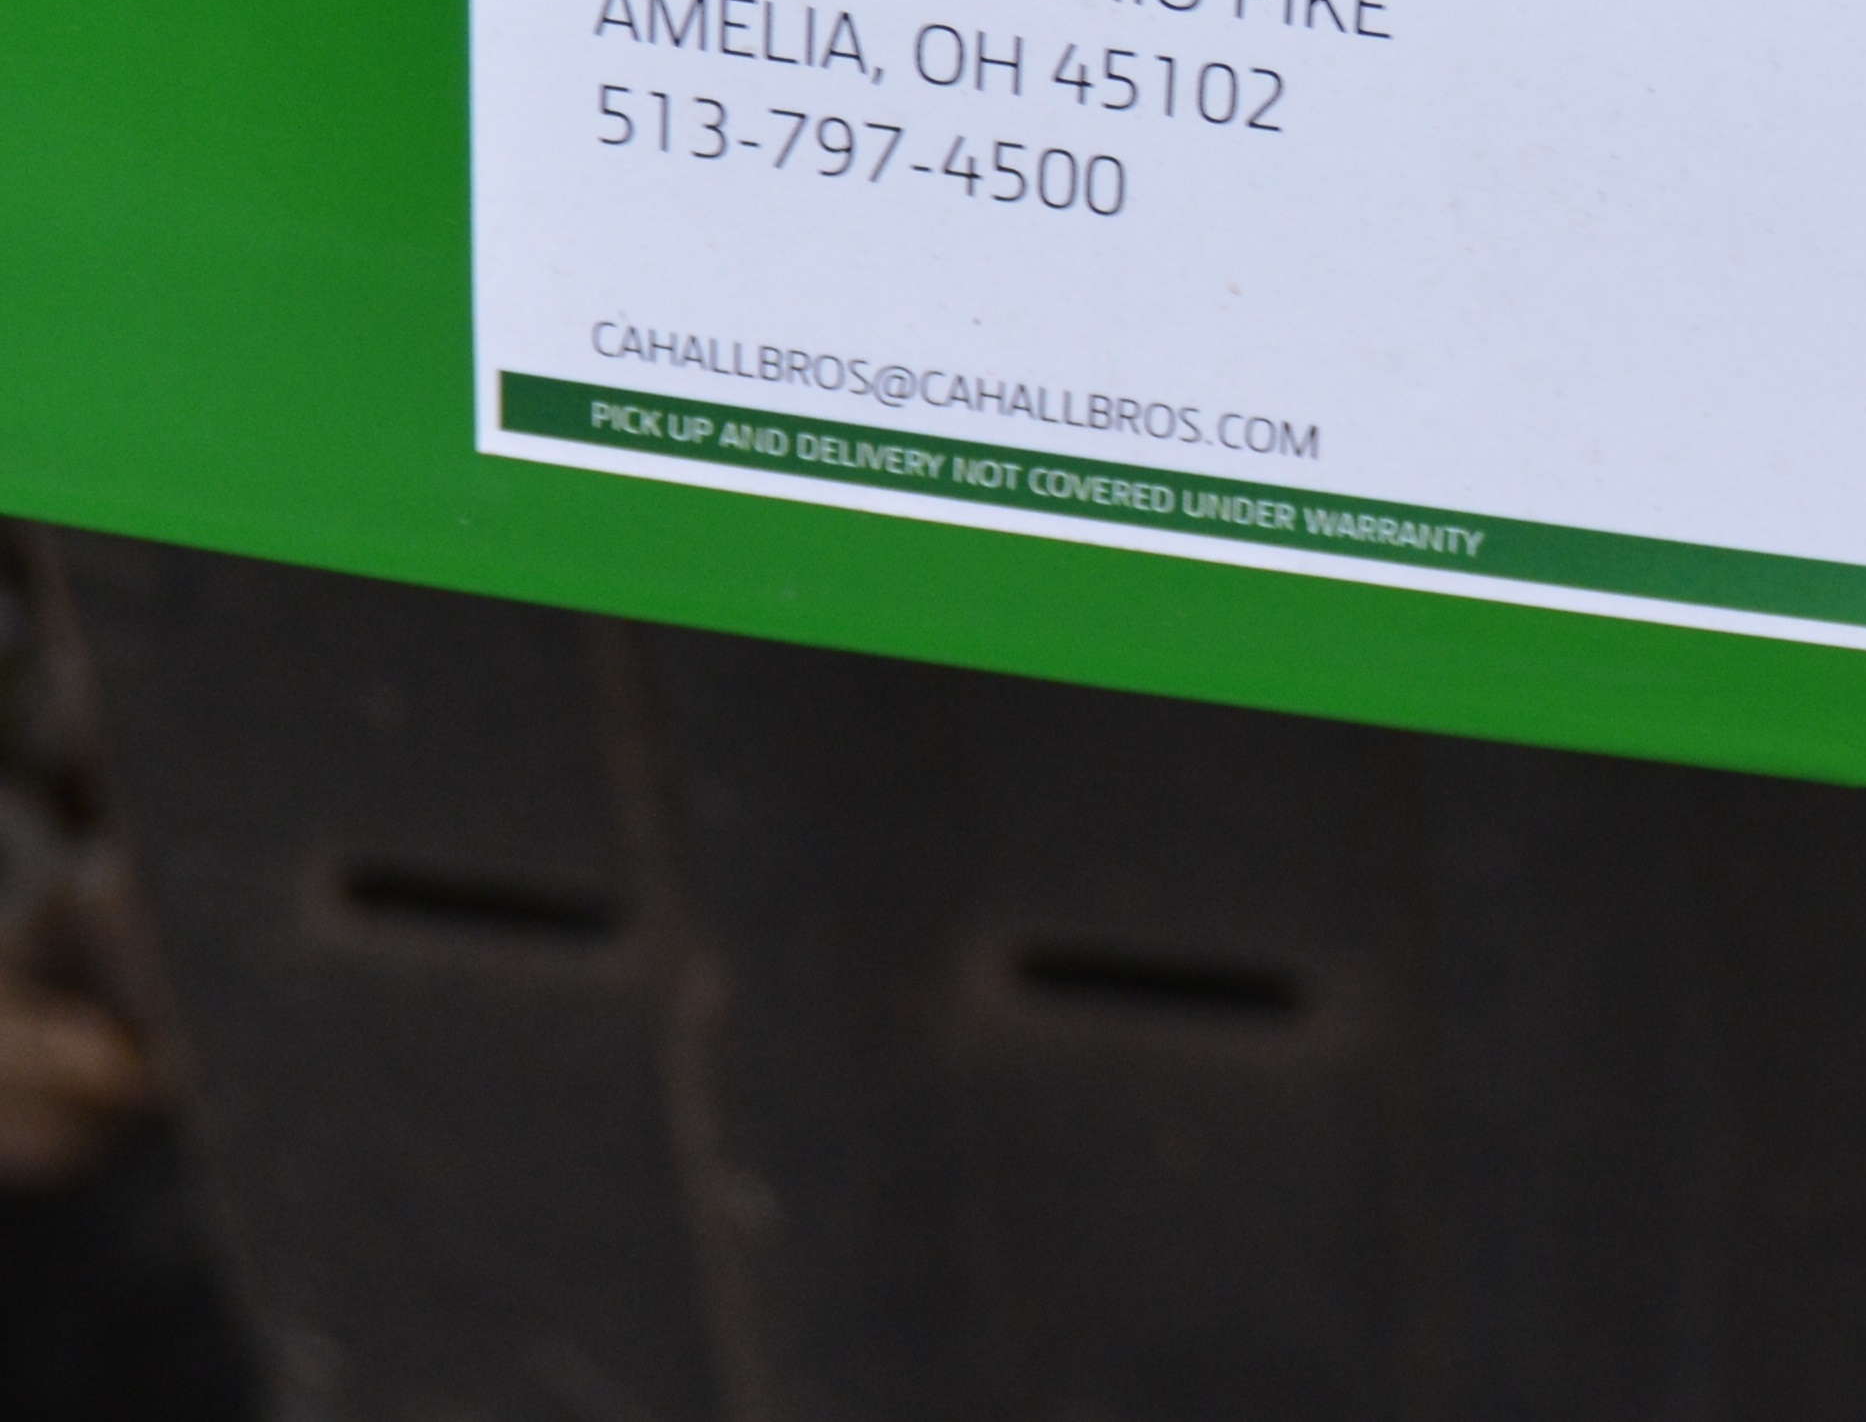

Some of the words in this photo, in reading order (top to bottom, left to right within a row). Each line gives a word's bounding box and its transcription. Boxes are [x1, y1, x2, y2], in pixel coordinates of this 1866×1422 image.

[914, 24, 1024, 95] OH
[1053, 43, 1285, 132] 45102
[597, 84, 1127, 216] 513-797-4500
[591, 321, 1321, 460] CAHALLBROS@CAHALLBROS.COM
[591, 402, 663, 438] PICK
[667, 412, 713, 443] UP
[719, 421, 789, 457] AND
[797, 433, 947, 478] DELIVERY
[952, 457, 1021, 491] NOT
[1029, 468, 1175, 514] COVERED
[1182, 492, 1296, 531] UNDER
[1302, 507, 1485, 558] WARRANTY
